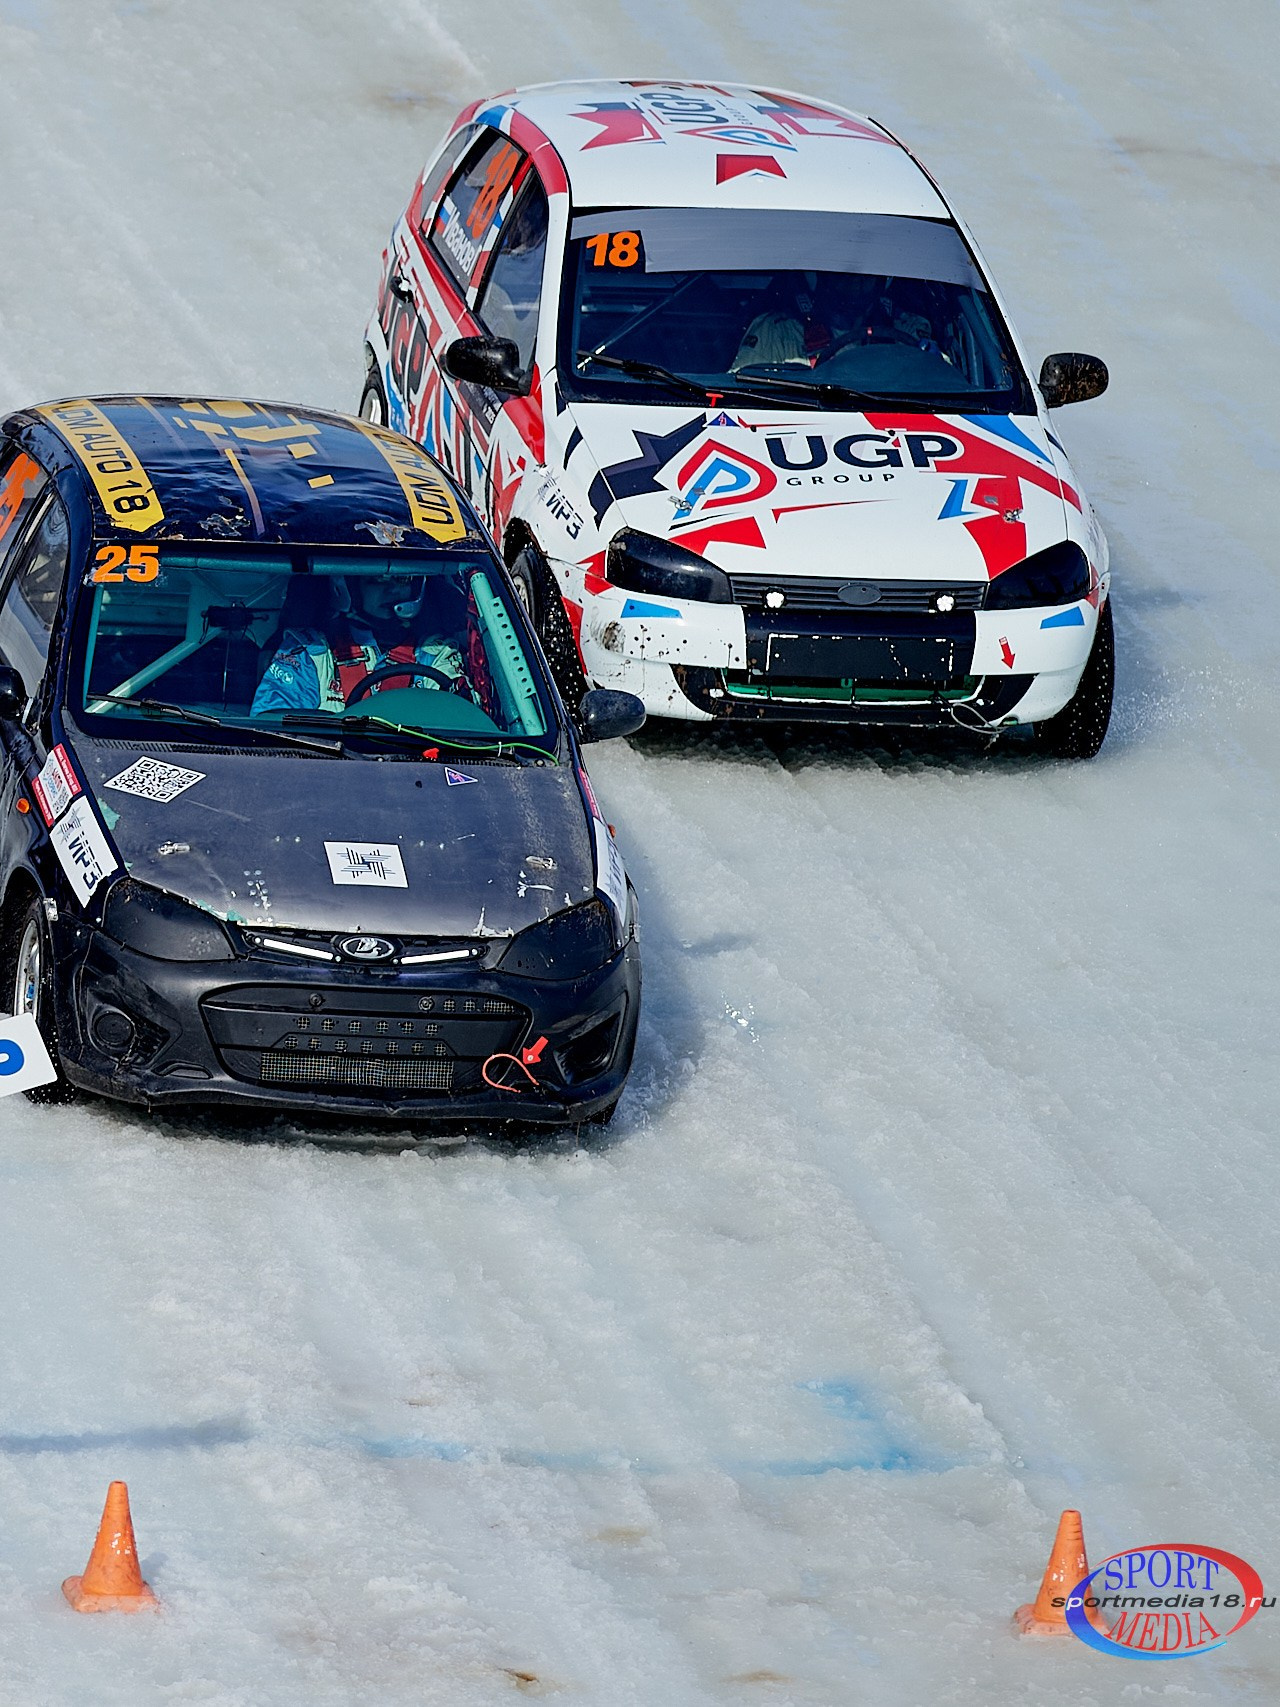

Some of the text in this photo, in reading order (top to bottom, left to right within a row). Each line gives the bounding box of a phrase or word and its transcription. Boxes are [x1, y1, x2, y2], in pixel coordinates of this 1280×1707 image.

[640, 93, 729, 123] UGP
[466, 142, 519, 239] 18
[586, 231, 639, 268] 18
[765, 433, 958, 472] UGP
[75, 433, 133, 473] AUTO
[108, 480, 150, 513] 18
[786, 473, 895, 487] GROUP
[404, 472, 454, 524] UDM
[93, 545, 160, 583] 25
